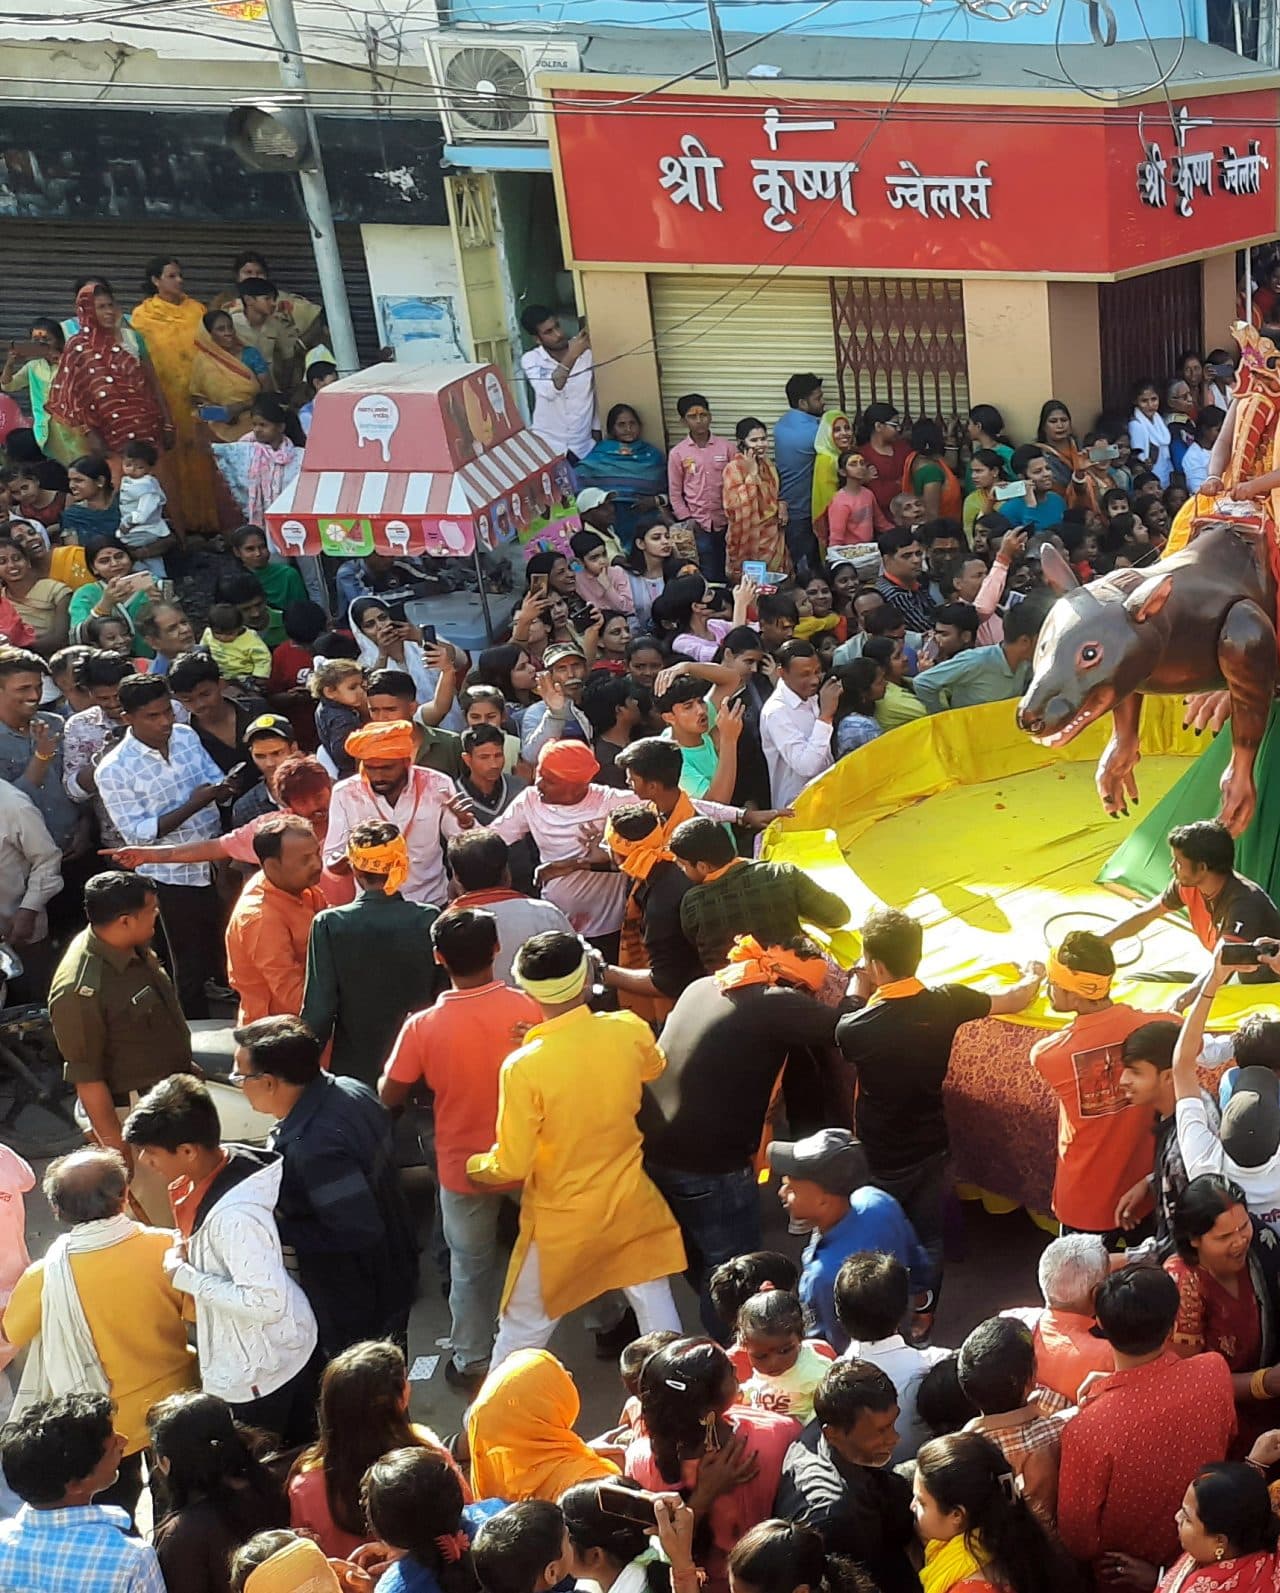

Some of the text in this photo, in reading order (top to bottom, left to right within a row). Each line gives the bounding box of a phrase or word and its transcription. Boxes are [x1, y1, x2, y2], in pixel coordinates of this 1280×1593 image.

[658, 134, 993, 233] श्री कृष्ण ज्वेलर्स
[1139, 140, 1262, 218] श्री कृष्ण ज्वेलर्स
